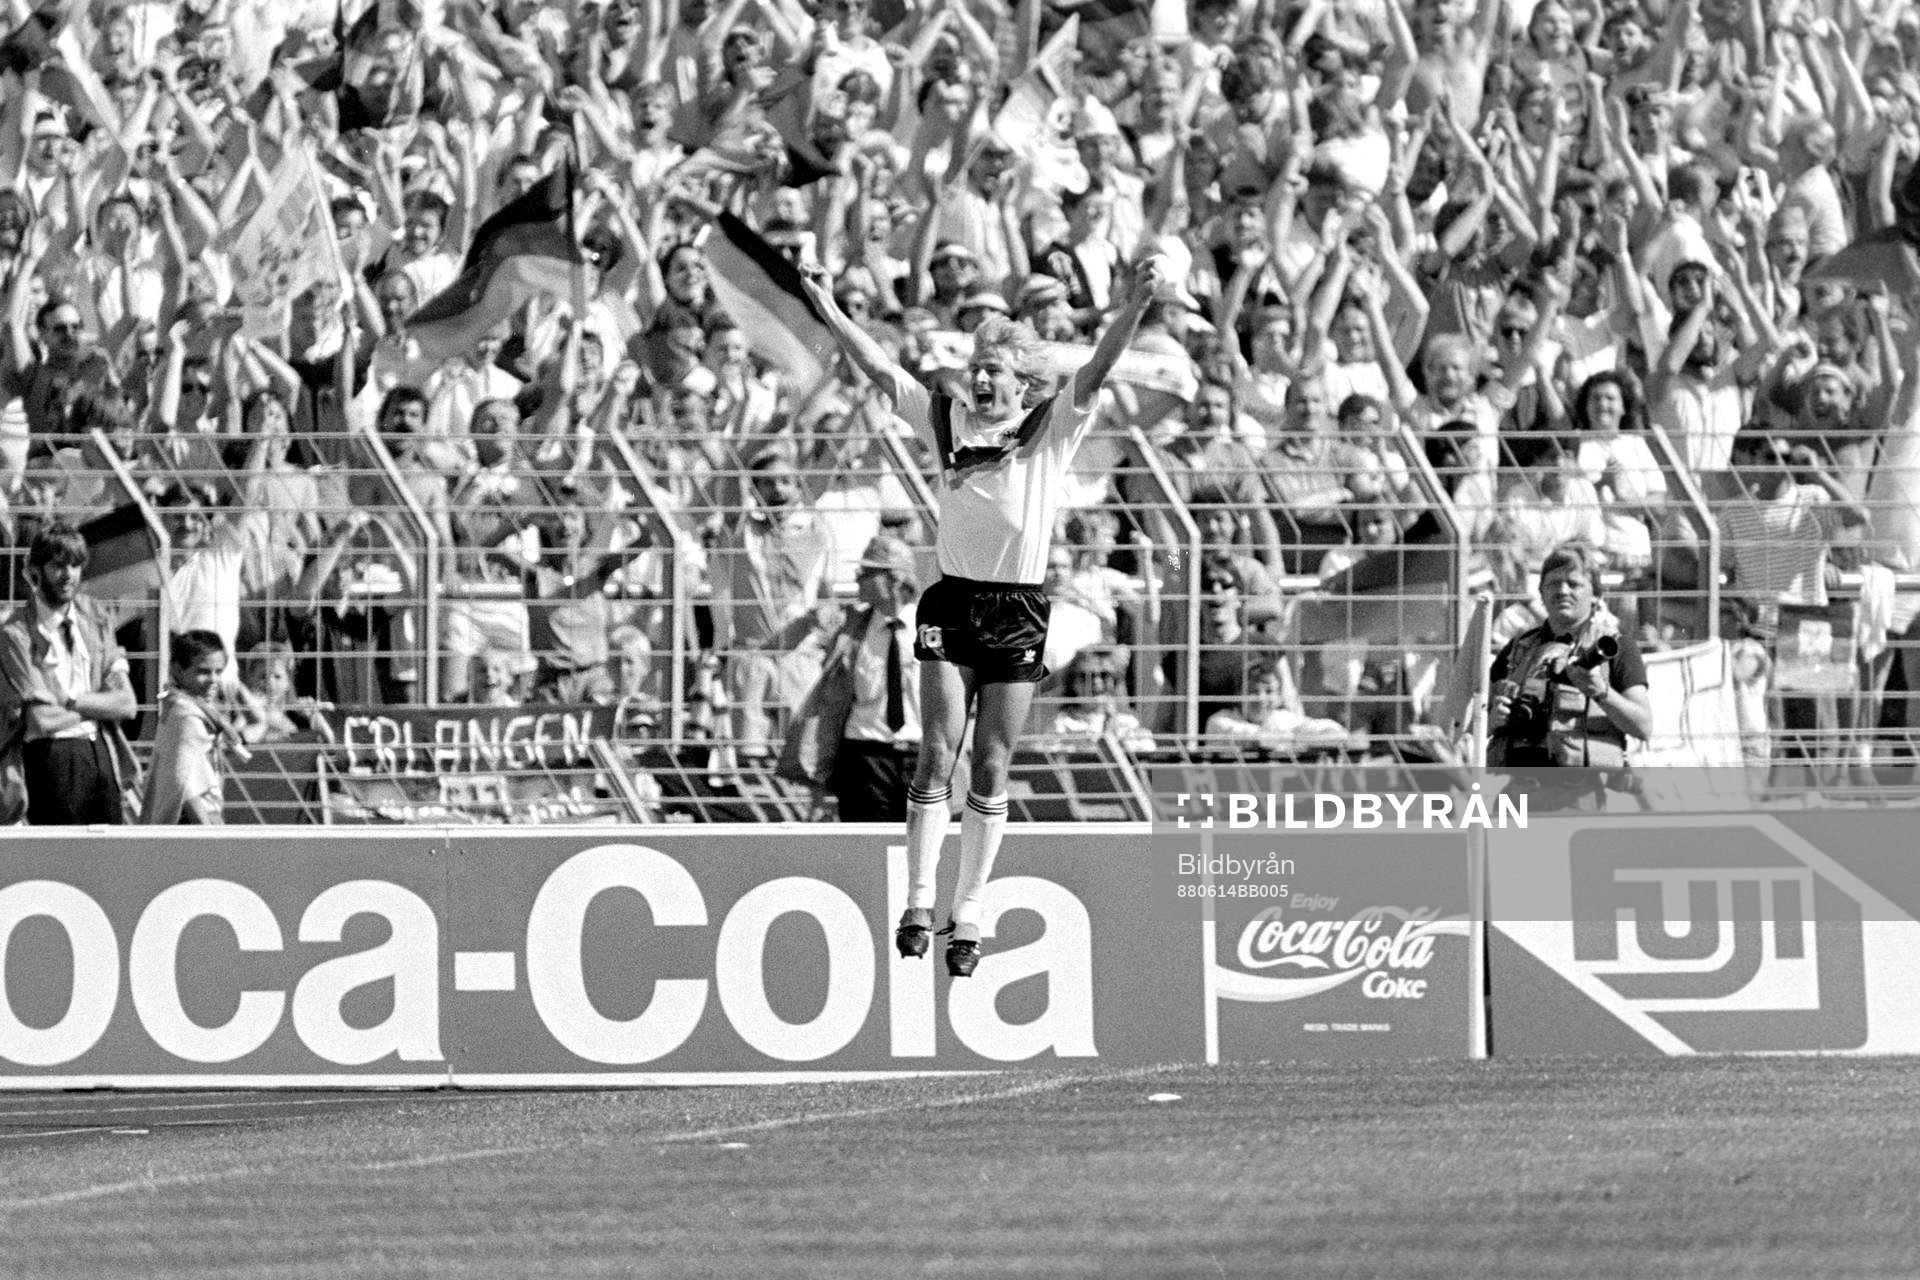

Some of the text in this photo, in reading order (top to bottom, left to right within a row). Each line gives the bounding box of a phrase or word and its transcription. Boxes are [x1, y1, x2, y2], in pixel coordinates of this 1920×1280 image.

[1289, 893, 1340, 911] Enjoy
[1237, 906, 1440, 969] Coca-Cola
[1362, 971, 1428, 999] Coke
